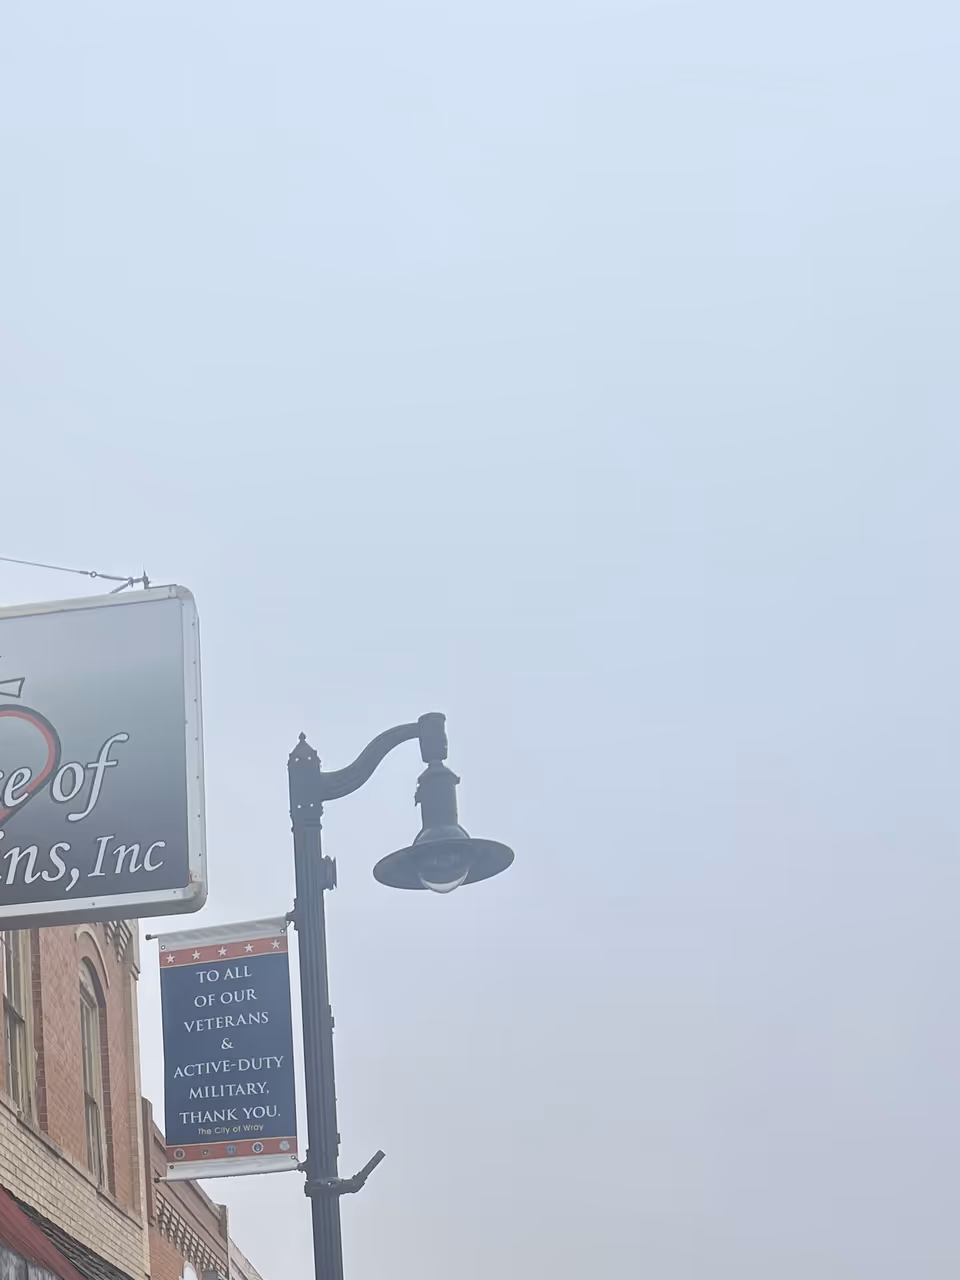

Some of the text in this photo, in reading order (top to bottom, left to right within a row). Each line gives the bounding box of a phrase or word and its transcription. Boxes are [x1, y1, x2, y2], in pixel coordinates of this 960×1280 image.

[51, 732, 130, 822] of
[88, 834, 167, 879] Inc
[196, 966, 252, 984] TO ALL
[194, 988, 258, 1008] OF OUR
[184, 1011, 269, 1033] VETERANS
[220, 1038, 234, 1050] &
[174, 1056, 284, 1078] ACTIVE-DUTY
[189, 1082, 270, 1100] MILITARY,
[179, 1105, 281, 1125] THANK YOU.
[198, 1123, 264, 1136] The City of Wray
